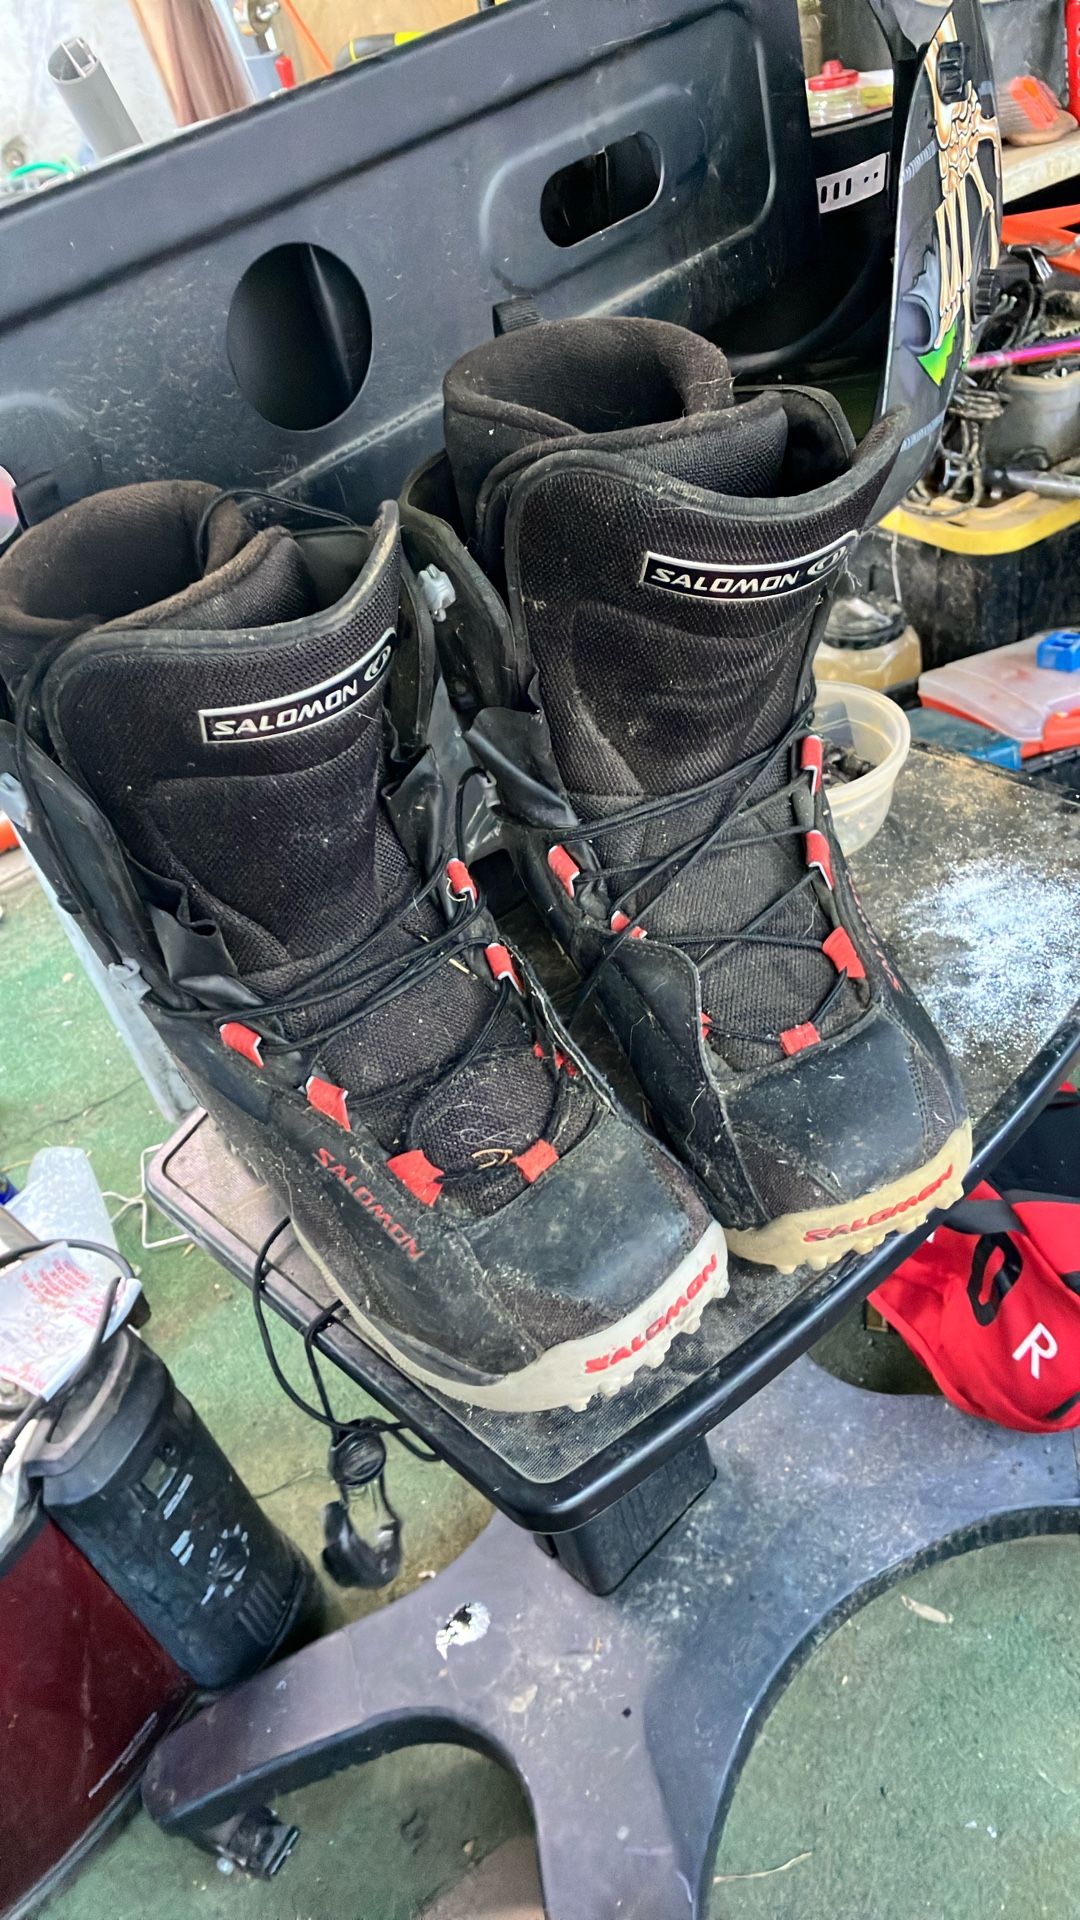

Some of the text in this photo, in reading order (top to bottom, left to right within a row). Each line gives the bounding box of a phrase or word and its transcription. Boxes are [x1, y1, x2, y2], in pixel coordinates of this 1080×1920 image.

[650, 567, 800, 594] SALOMON
[212, 679, 358, 736] SALOMON
[312, 1147, 425, 1261] SALOMON
[585, 1254, 717, 1374] SALOMON
[1012, 1322, 1058, 1380] R
